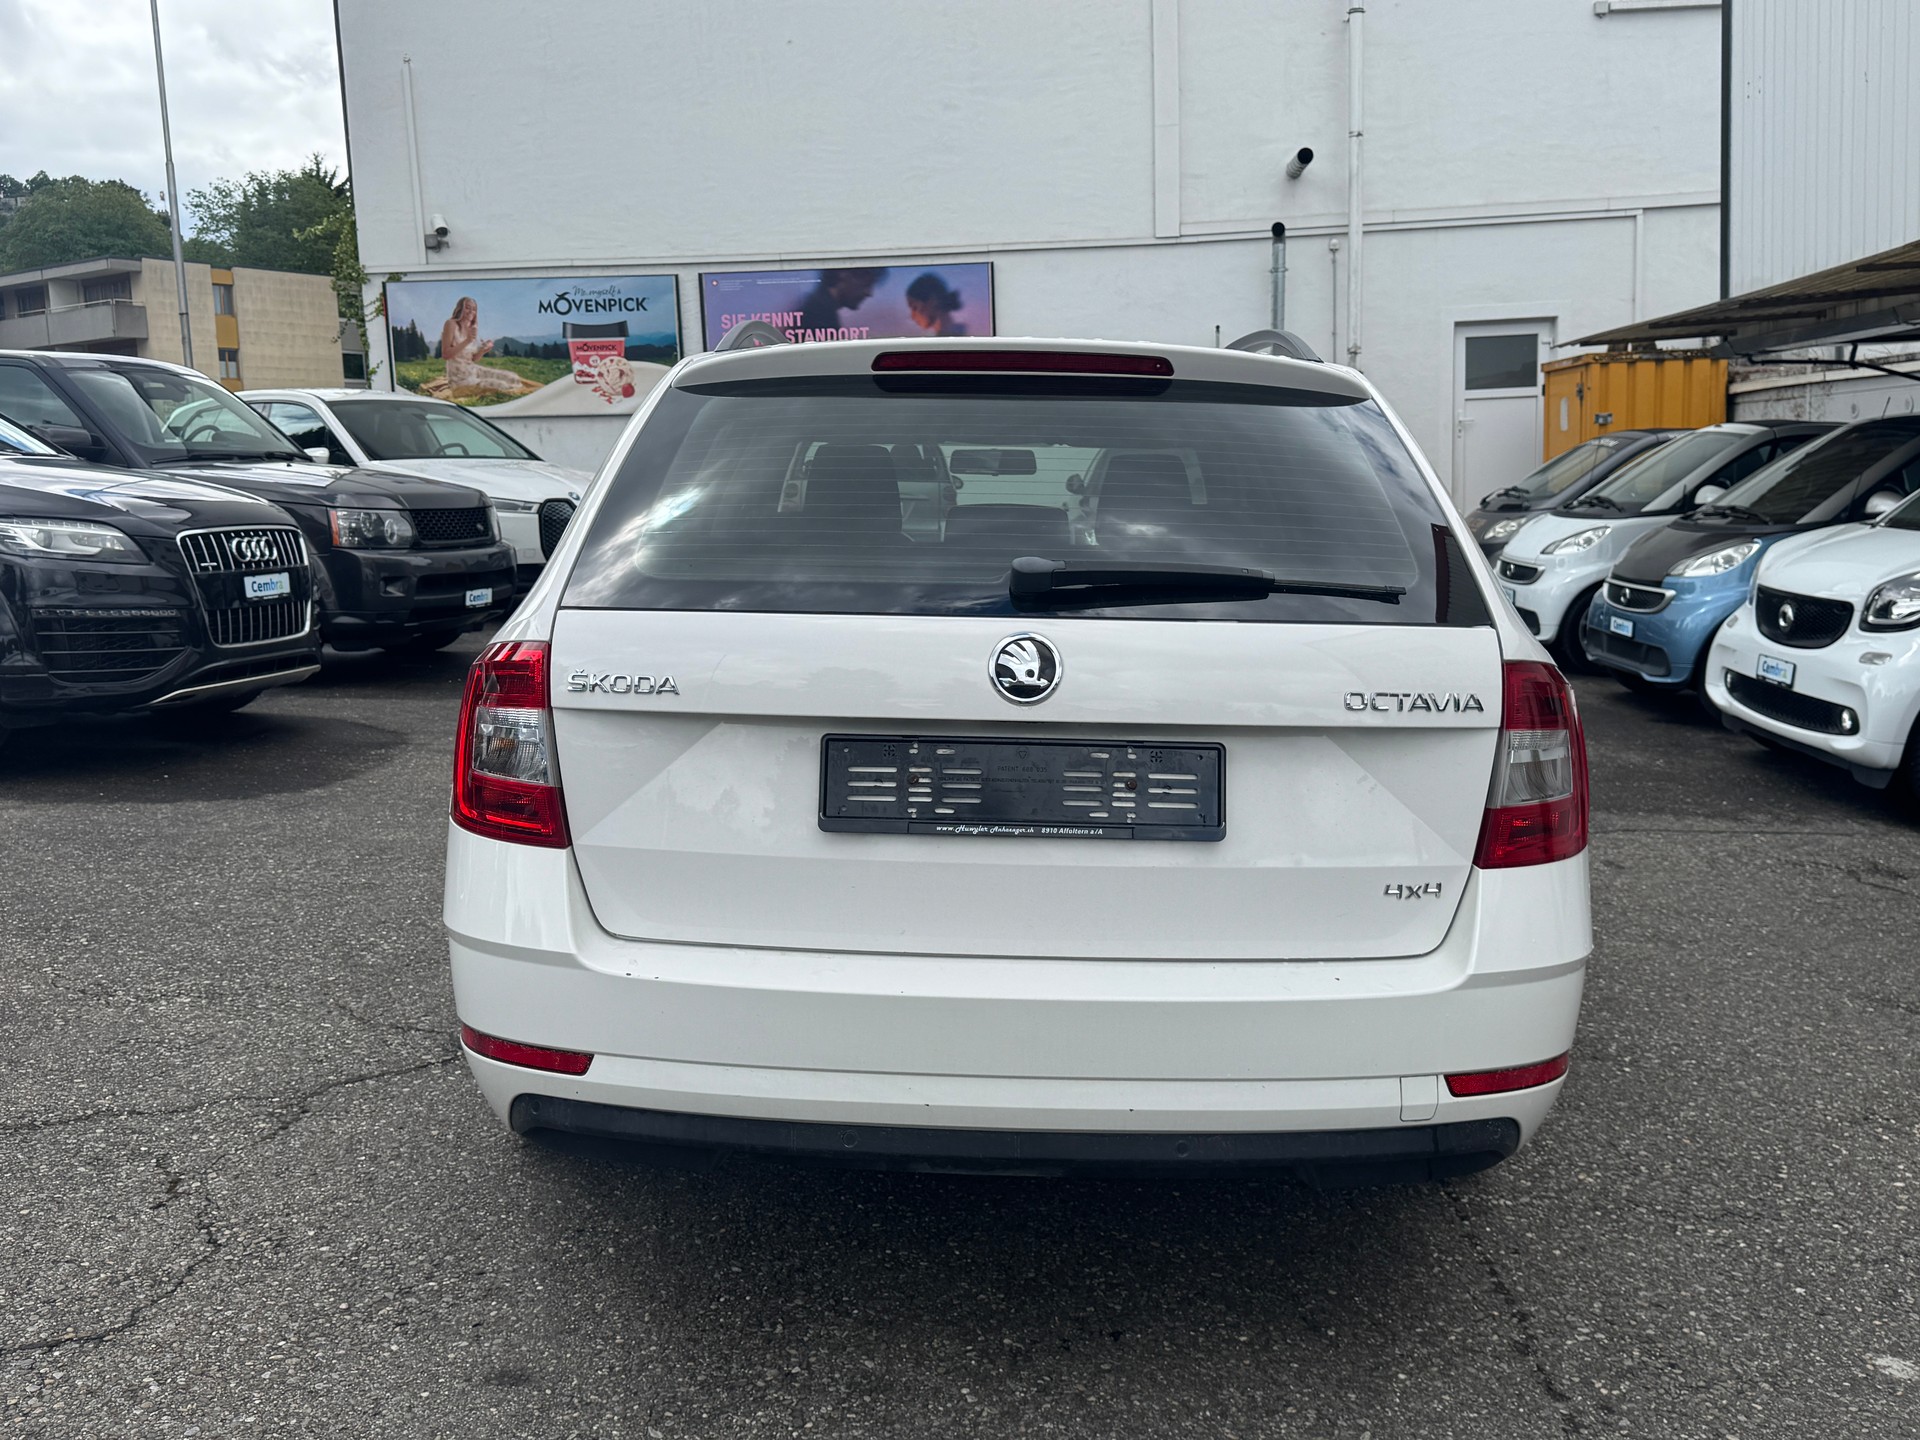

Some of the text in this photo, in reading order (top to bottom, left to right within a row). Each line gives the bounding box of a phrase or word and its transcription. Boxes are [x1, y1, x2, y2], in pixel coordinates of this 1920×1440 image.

[785, 326, 870, 344] STANDORT
[251, 577, 284, 593] Cembra
[567, 668, 681, 696] ŠKODA
[1343, 691, 1485, 713] OCTAVIA
[1383, 882, 1442, 901] 4x4
